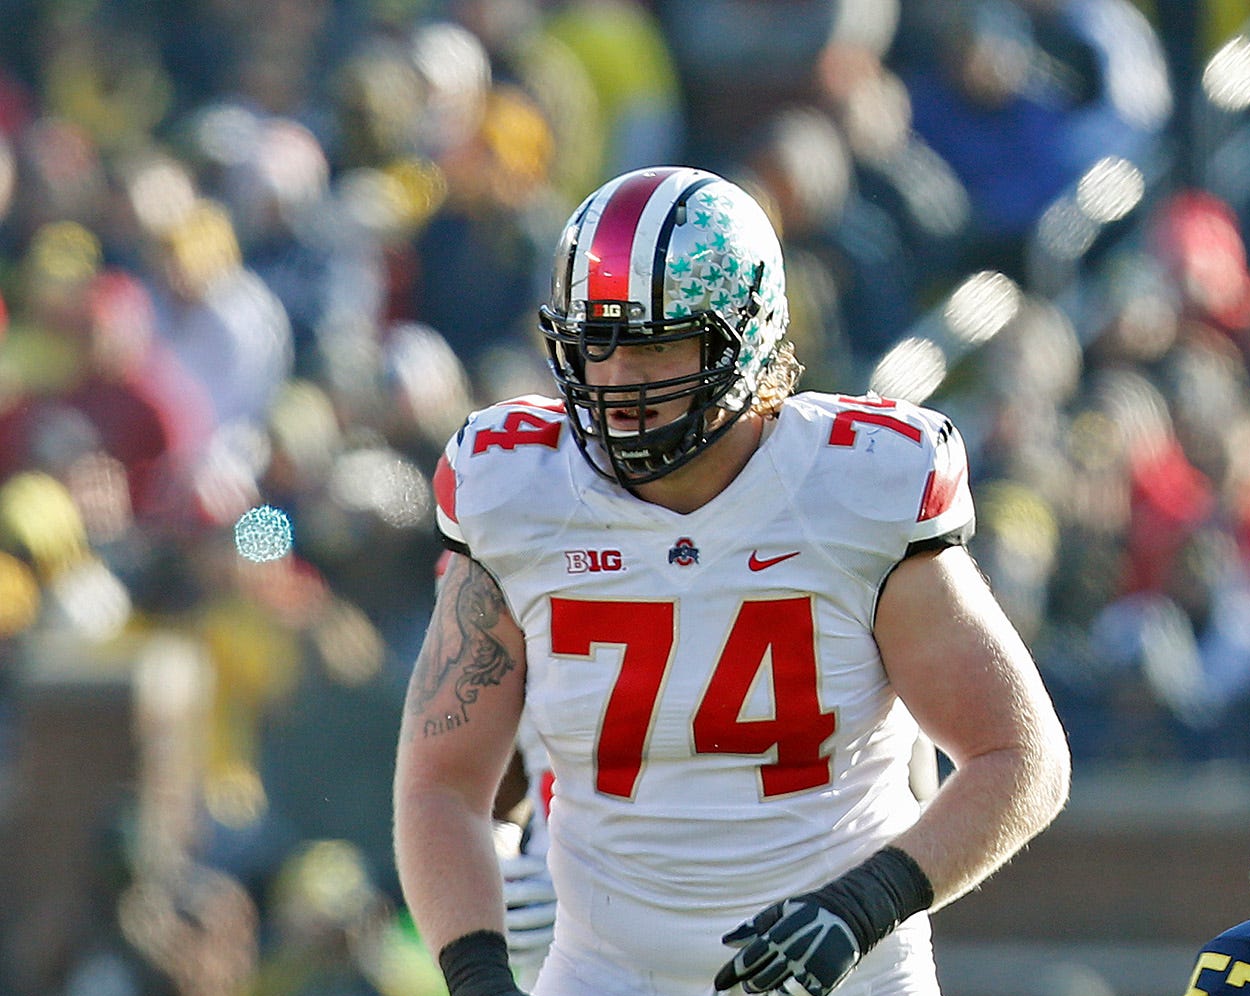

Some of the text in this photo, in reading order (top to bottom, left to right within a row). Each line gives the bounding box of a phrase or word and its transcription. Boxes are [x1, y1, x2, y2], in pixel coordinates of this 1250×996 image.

[472, 401, 566, 456] 4
[827, 397, 923, 447] 7
[549, 593, 837, 801] 74
